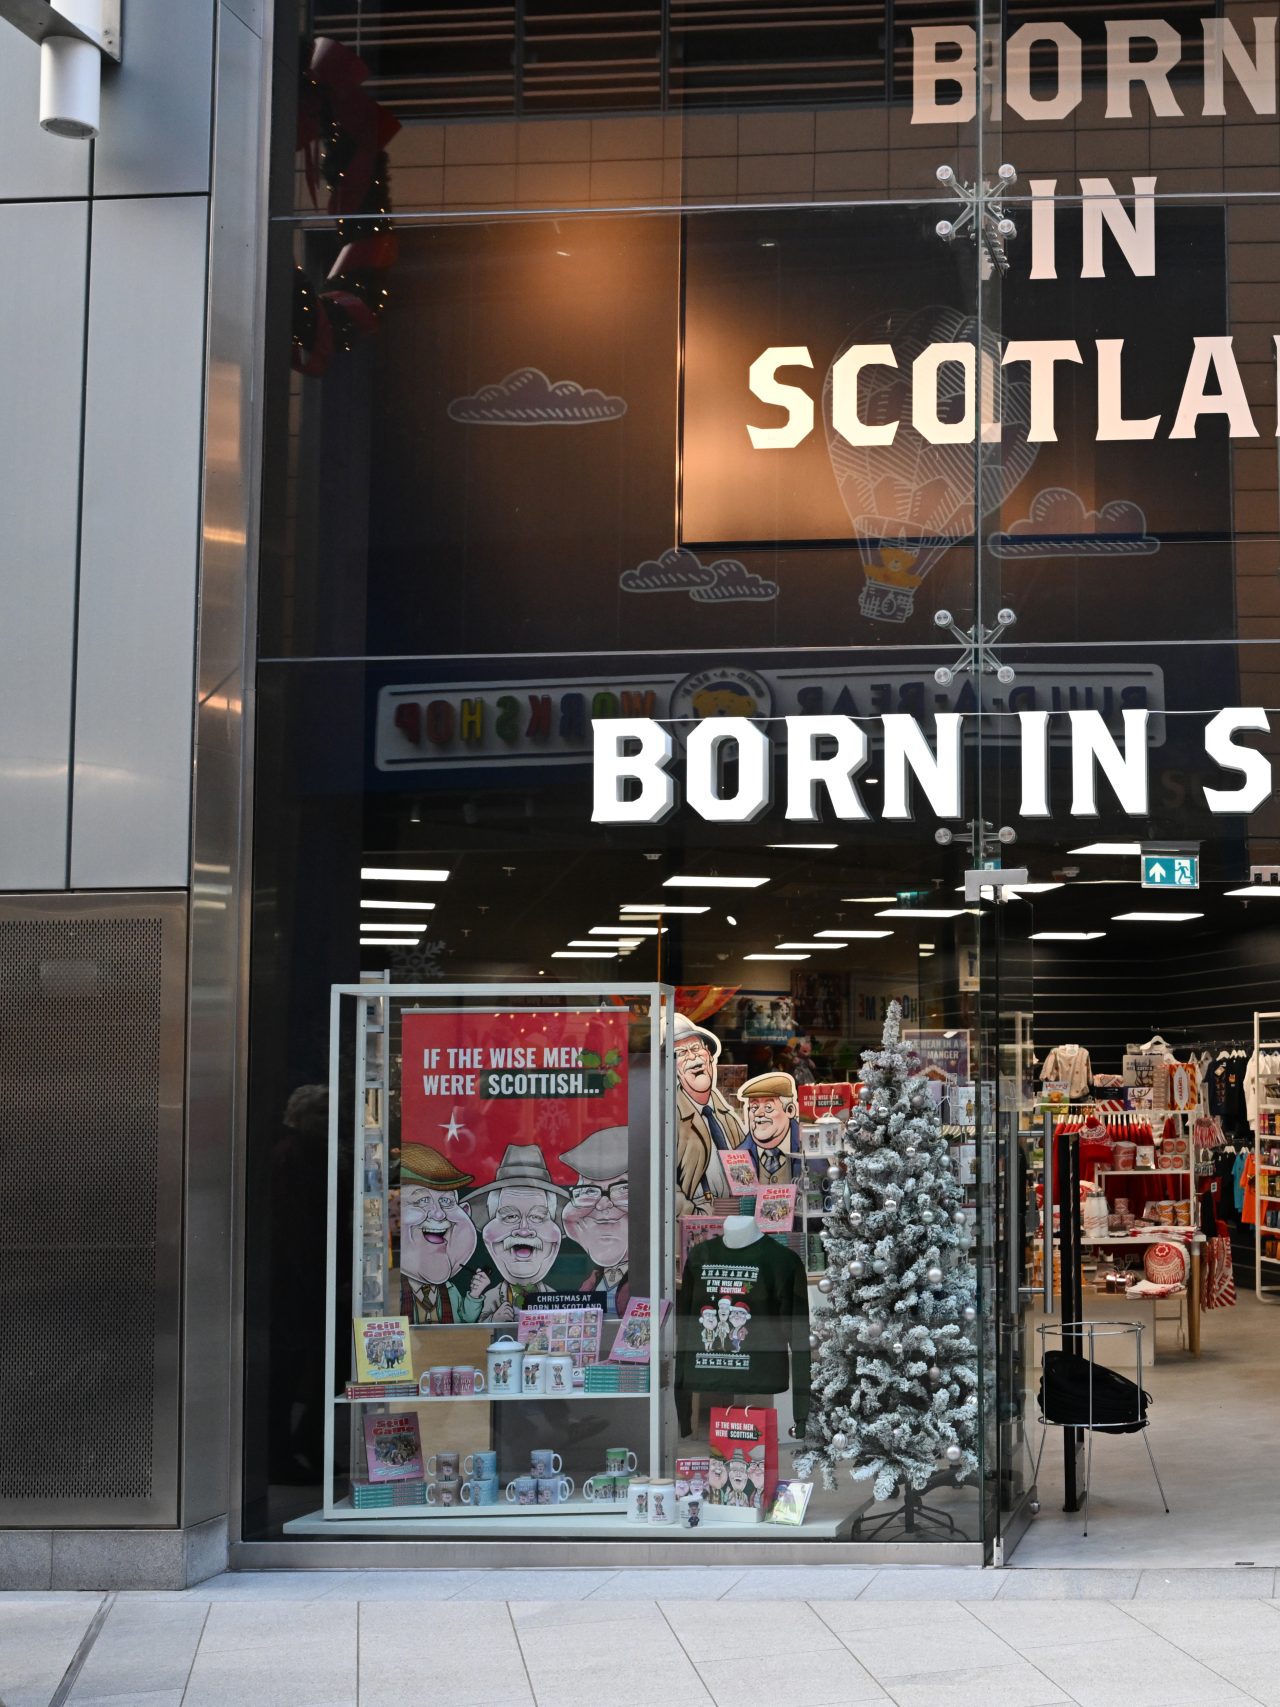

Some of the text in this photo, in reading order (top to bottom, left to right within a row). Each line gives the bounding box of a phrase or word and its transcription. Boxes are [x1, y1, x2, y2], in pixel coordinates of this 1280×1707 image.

[910, 16, 1278, 125] BORN
[1029, 176, 1157, 280] IN
[591, 713, 965, 825] BORN
[1018, 709, 1150, 818] IN
[423, 1047, 583, 1070] IF THE WISE MEN
[423, 1075, 475, 1096] WERE
[537, 1294, 592, 1303] CHRISTMAS AT
[367, 1321, 400, 1330] Still
[363, 1330, 405, 1338] Game
[376, 1418, 409, 1428] Still
[372, 1427, 415, 1435] Game
